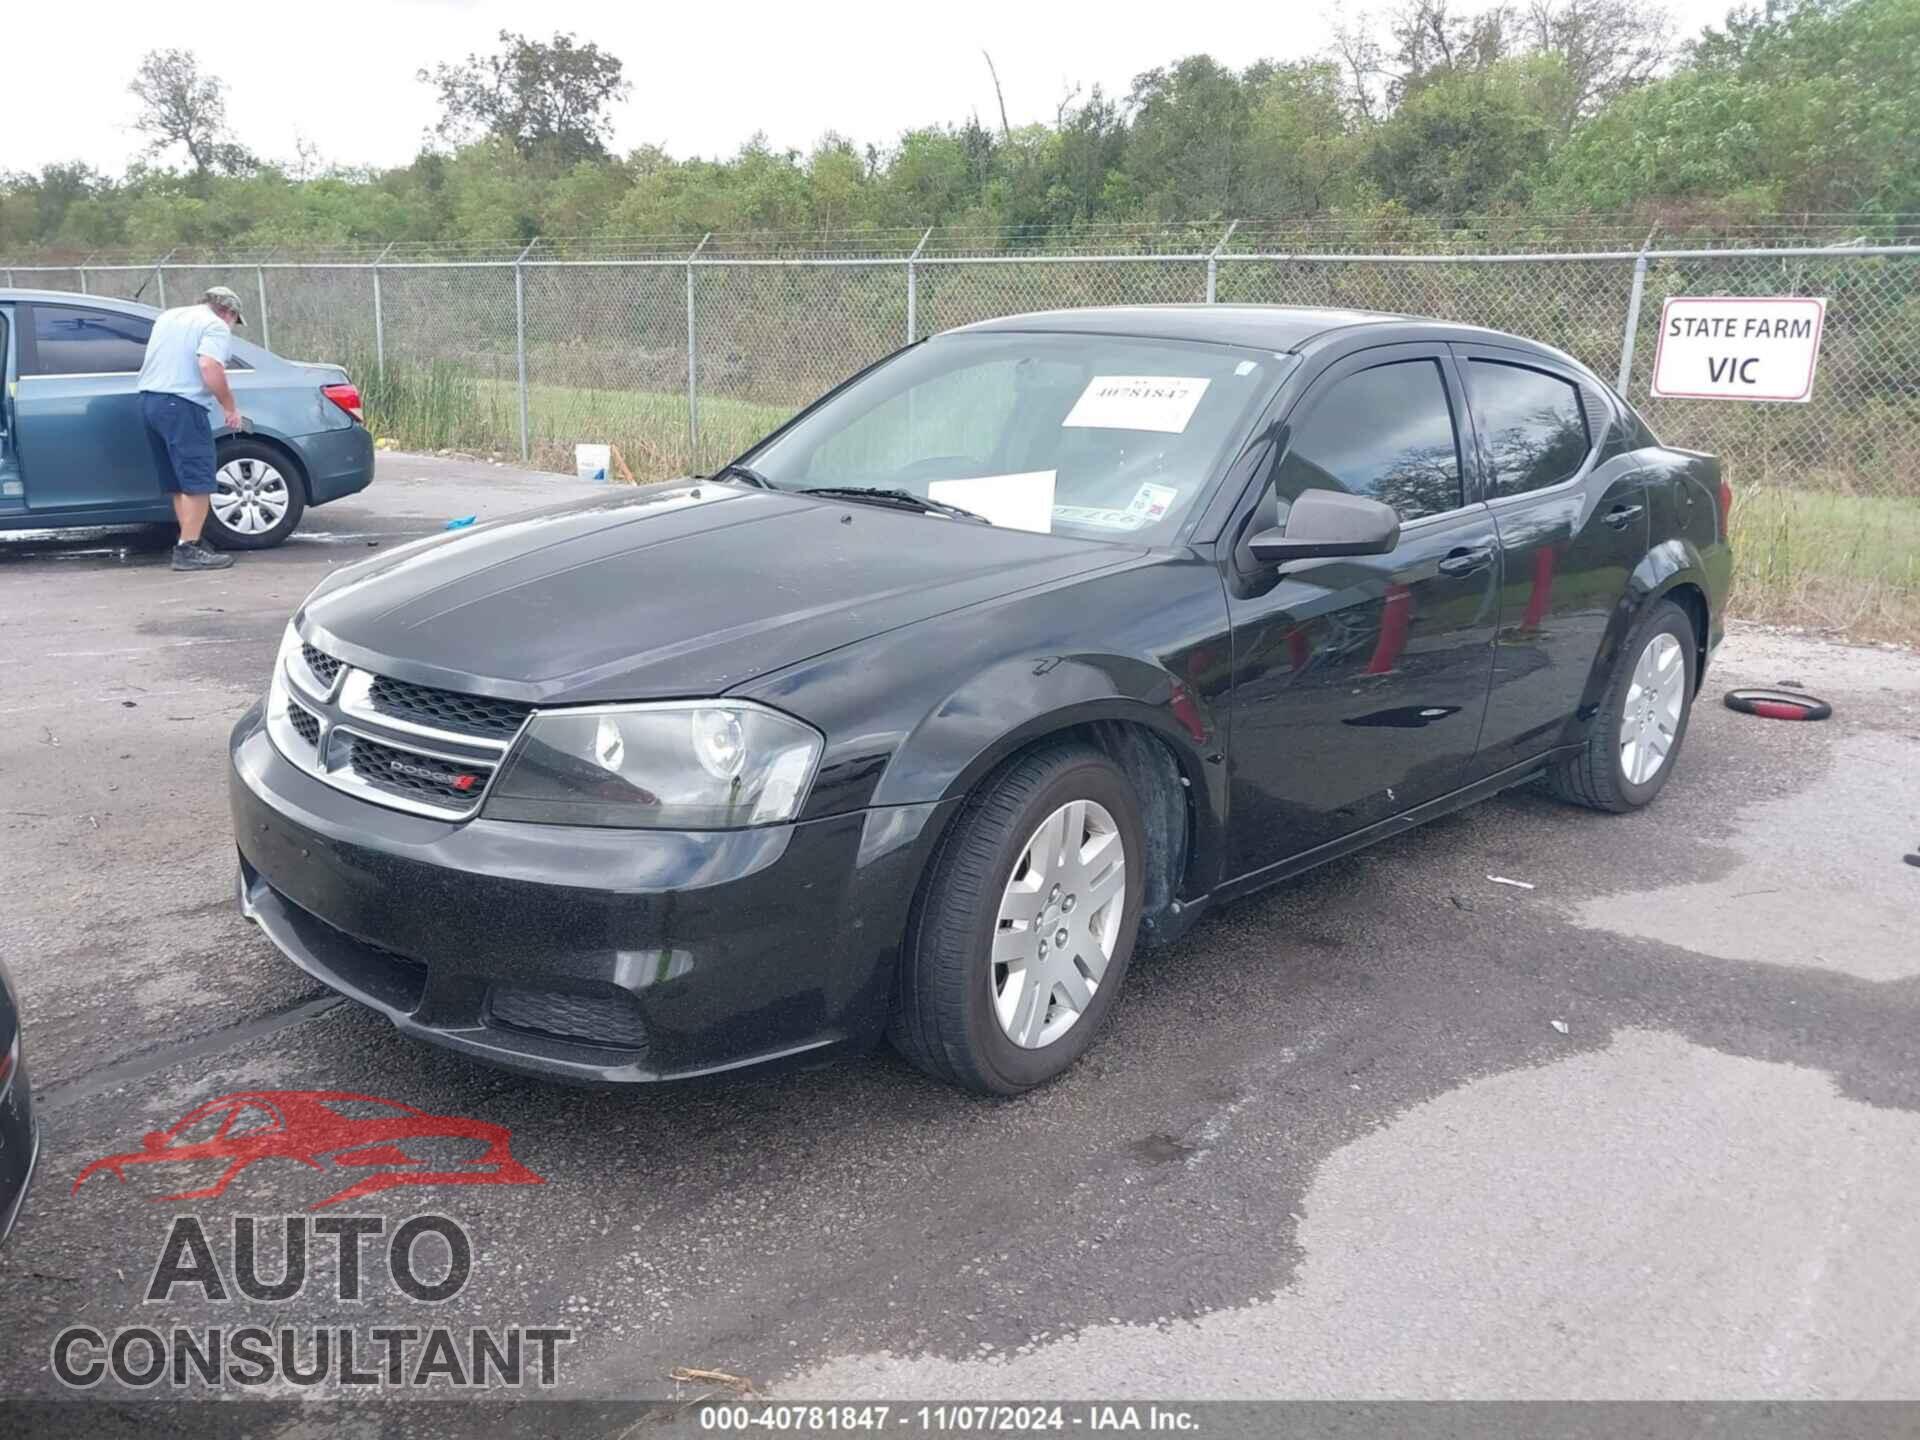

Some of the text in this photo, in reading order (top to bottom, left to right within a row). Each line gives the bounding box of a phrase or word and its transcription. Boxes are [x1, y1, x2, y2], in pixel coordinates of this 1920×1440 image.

[1669, 317, 1812, 339] STATE FARM
[1708, 356, 1760, 384] VIC
[1096, 387, 1189, 400] 40781847
[391, 761, 457, 784] DODGE
